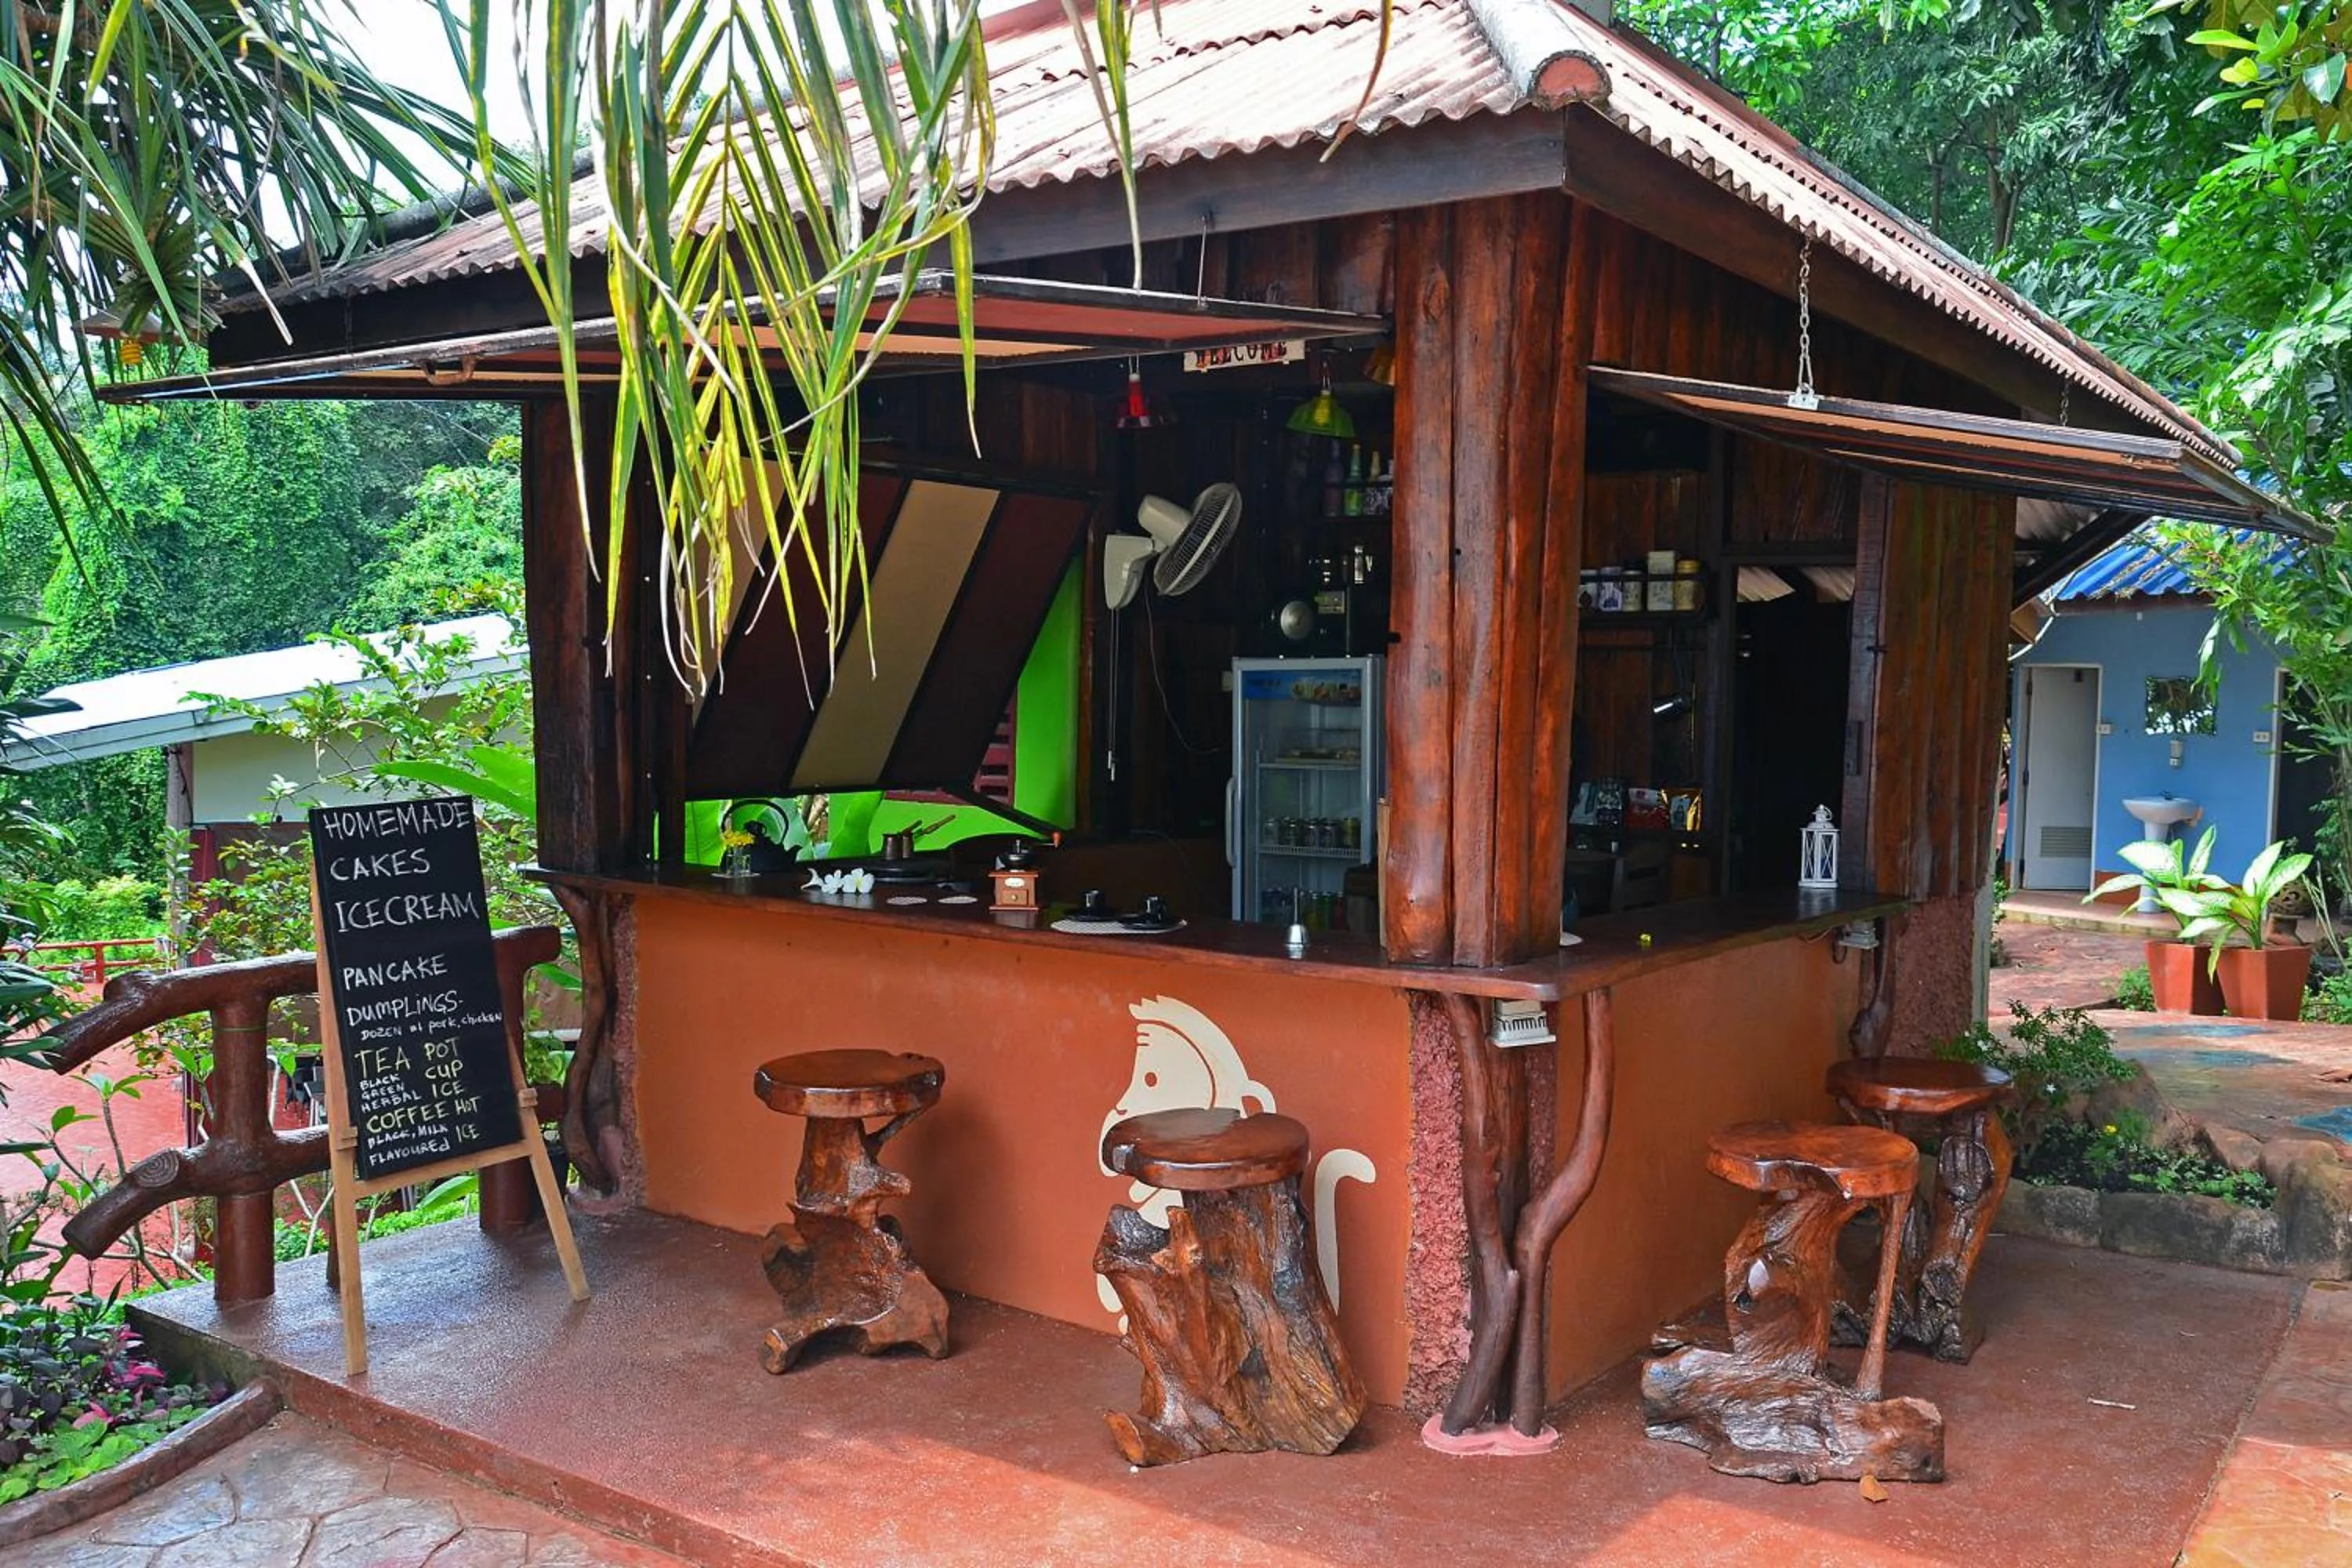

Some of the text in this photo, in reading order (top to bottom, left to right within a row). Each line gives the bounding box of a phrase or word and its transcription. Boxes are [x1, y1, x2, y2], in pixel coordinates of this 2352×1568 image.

[322, 801, 470, 840] HOMEMADE
[330, 848, 431, 881] CAKES
[335, 891, 480, 933] ICECREAM
[343, 953, 448, 991] PANCAKE
[354, 1036, 460, 1079] TEA POT
[424, 1059, 464, 1080] CUP
[359, 1073, 401, 1091] BLACK
[361, 1081, 405, 1101] GREEN
[431, 1080, 466, 1099] ICE
[361, 1089, 423, 1114] HERBAL
[365, 1095, 481, 1134] COFFEE HOT
[456, 1123, 481, 1143] ICE
